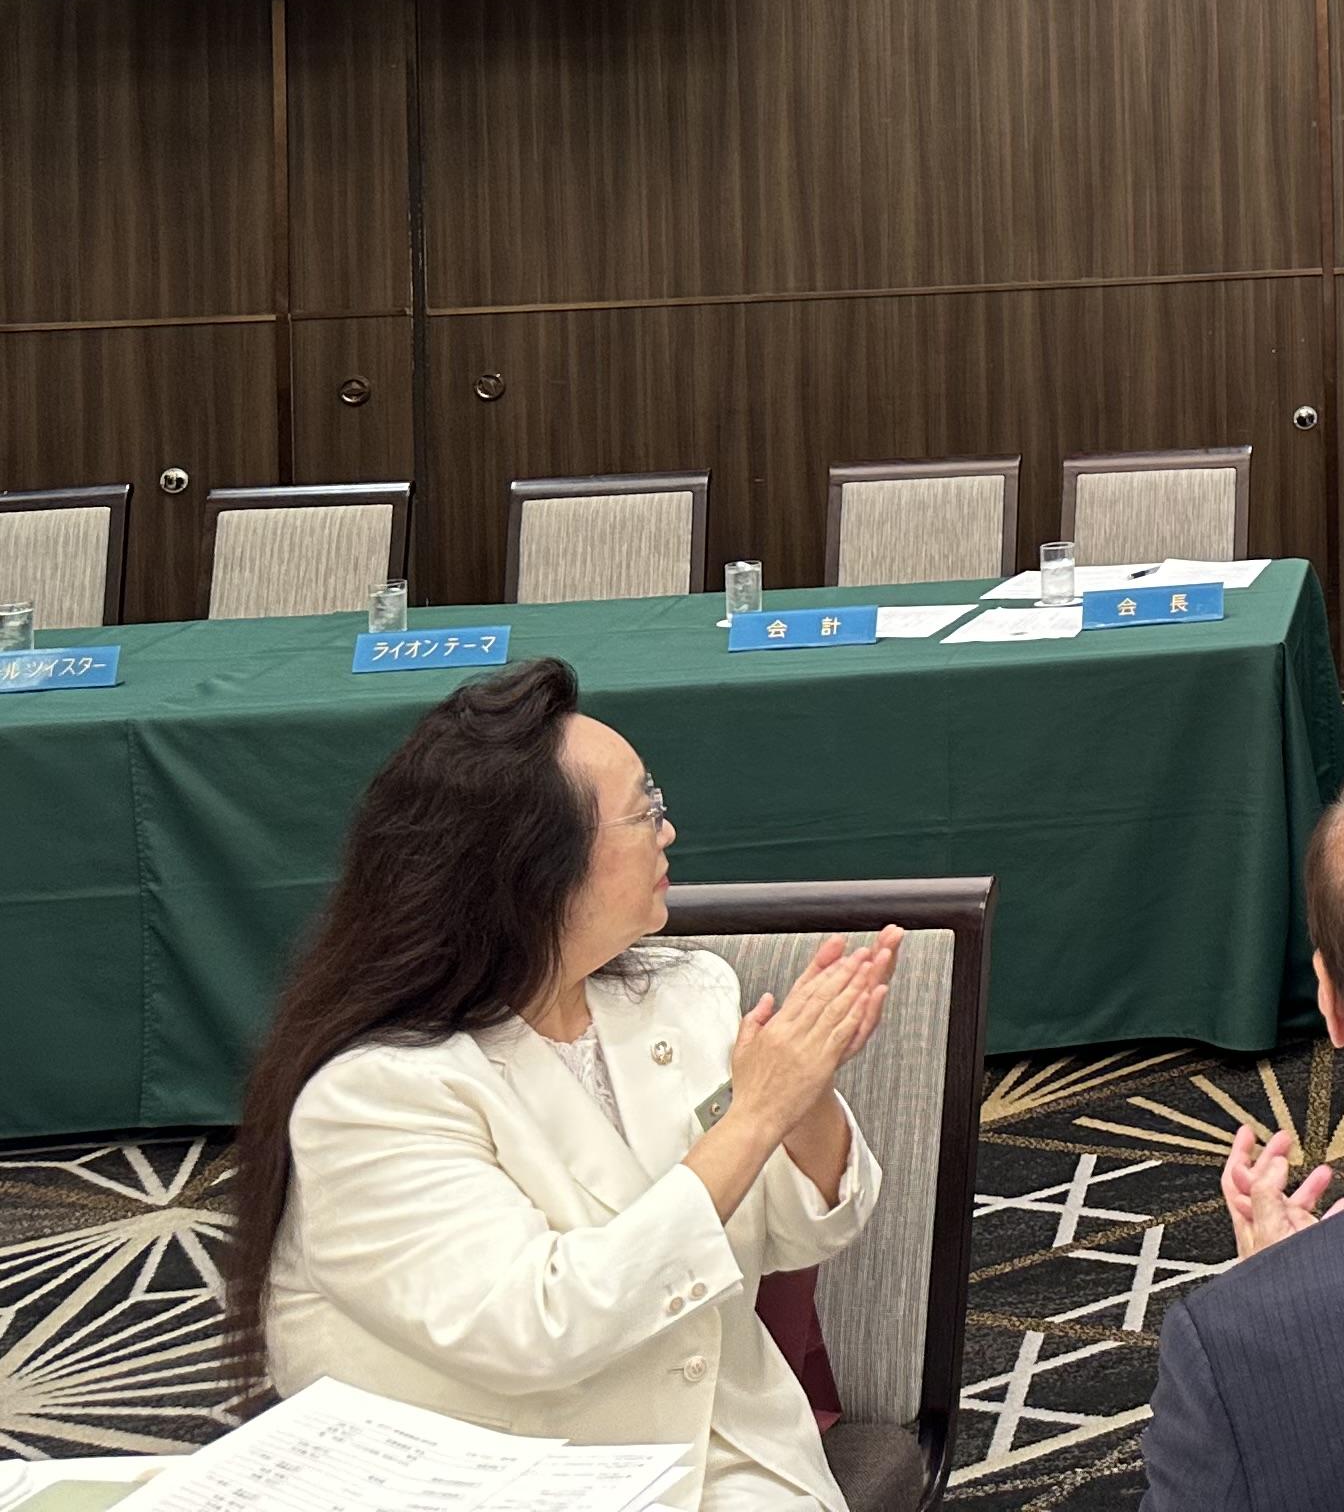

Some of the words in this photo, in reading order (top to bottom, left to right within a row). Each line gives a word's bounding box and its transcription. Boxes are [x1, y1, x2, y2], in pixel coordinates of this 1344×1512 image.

[1117, 593, 1189, 618] 会長
[766, 616, 842, 640] 会計
[0, 657, 107, 681] ルツイスター
